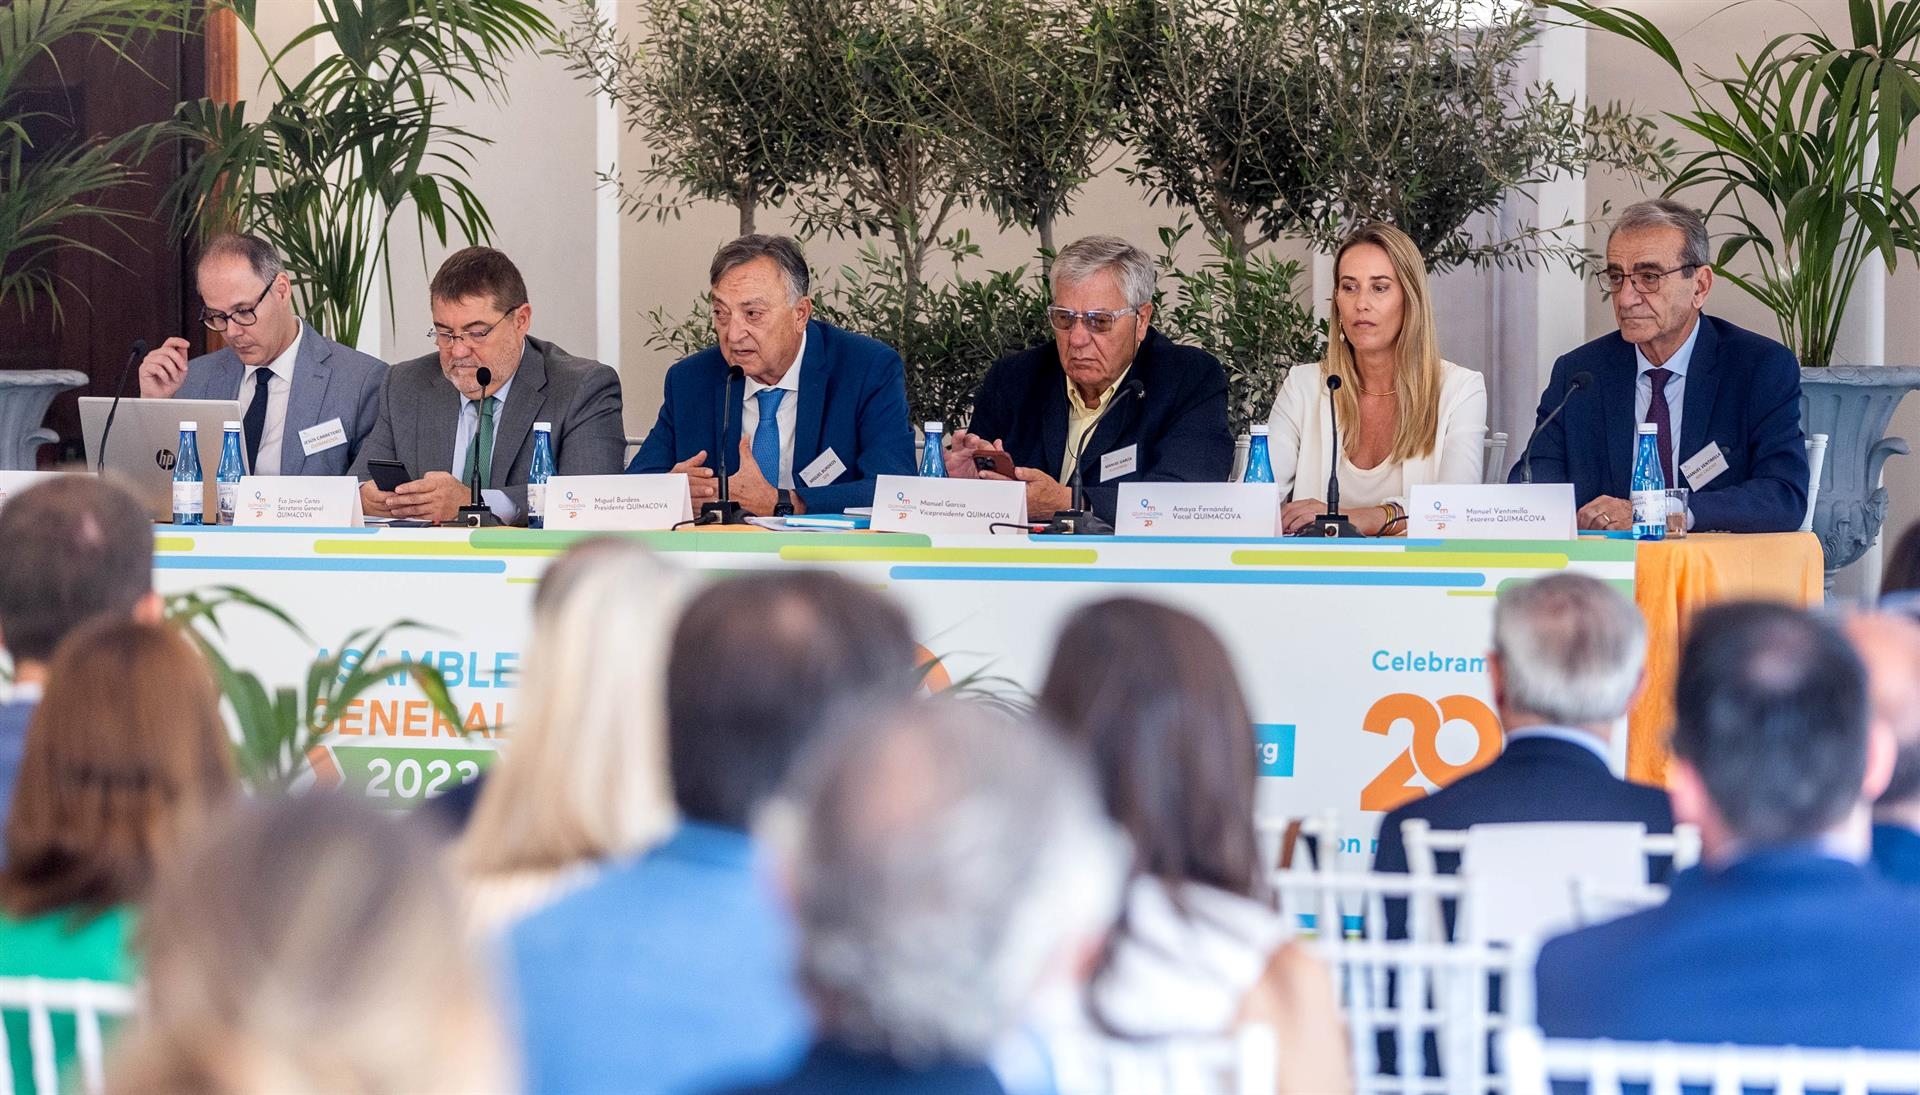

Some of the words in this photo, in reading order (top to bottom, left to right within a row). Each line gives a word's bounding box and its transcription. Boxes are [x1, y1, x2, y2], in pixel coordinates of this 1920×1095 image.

[158, 449, 174, 470] hp
[594, 496, 615, 504] Miguel
[626, 502, 668, 510] QUIMACOVA
[1172, 505, 1197, 513] Amaya
[919, 509, 964, 518] Vicepresidente
[966, 510, 1010, 519] QUIMACOVA
[1466, 507, 1492, 515] Manuel
[1172, 512, 1192, 520] Vocal
[1193, 512, 1242, 520] QUIMACOVA
[1496, 514, 1546, 522] QUIMACOVA
[313, 648, 521, 689] SMBLE
[1360, 692, 1504, 812] 20
